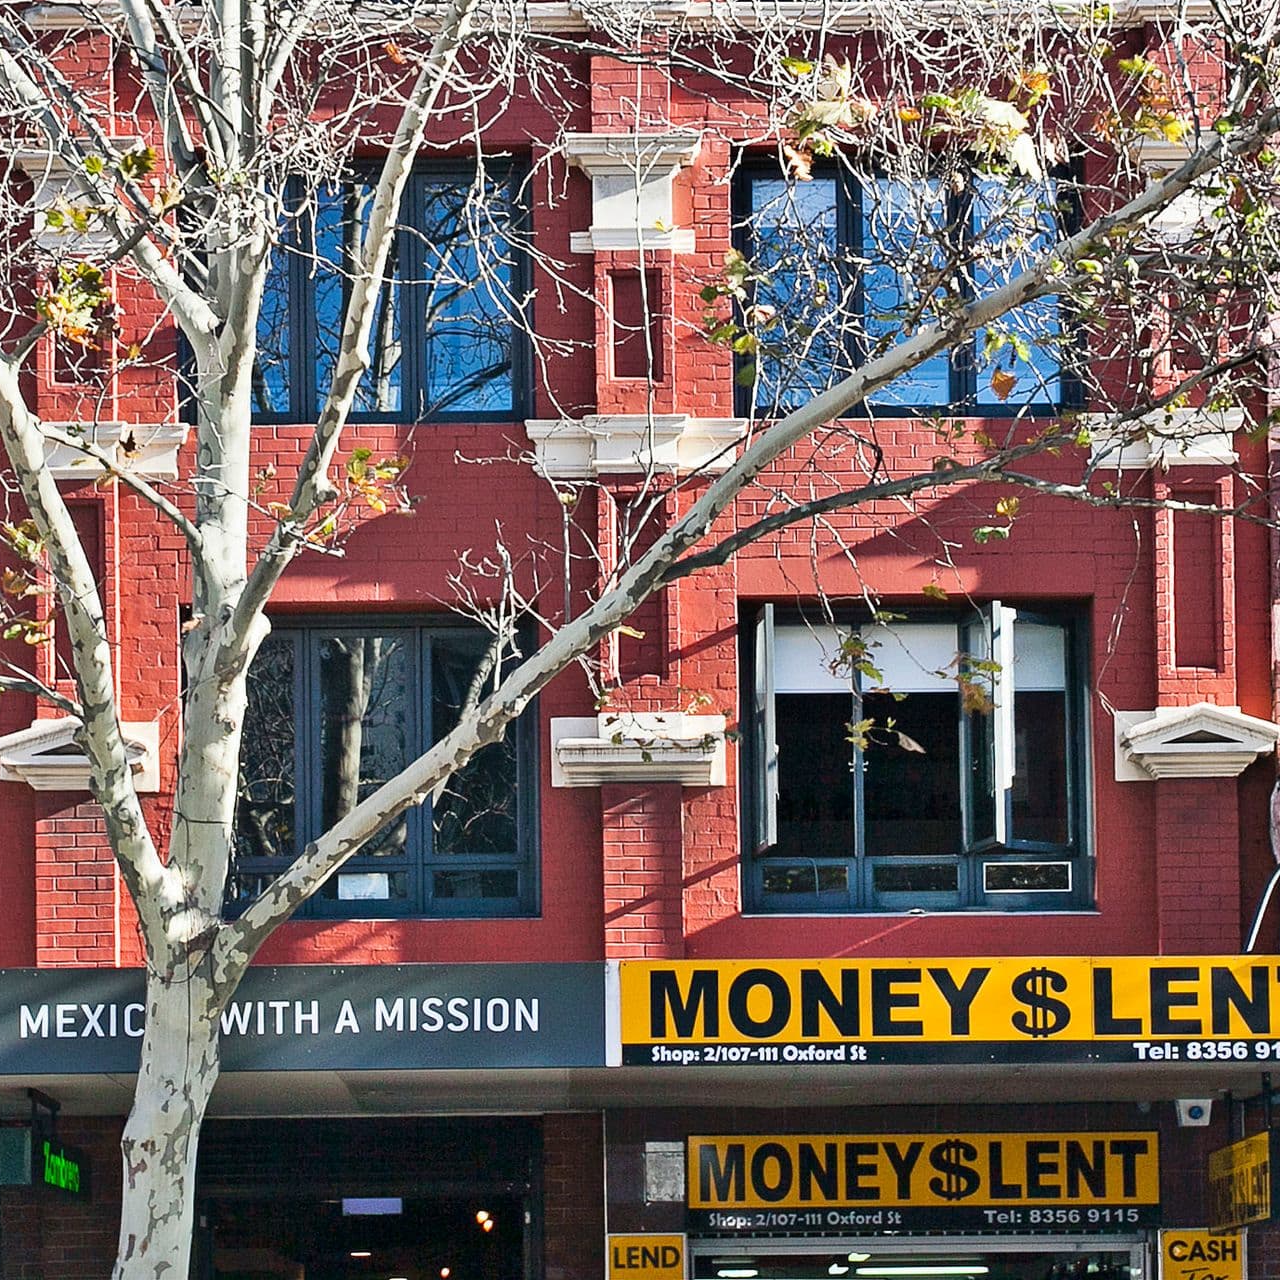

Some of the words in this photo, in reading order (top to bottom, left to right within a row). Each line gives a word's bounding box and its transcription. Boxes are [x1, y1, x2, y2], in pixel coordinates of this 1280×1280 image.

[20, 1004, 146, 1038] MEXIC
[220, 1001, 319, 1035] WITH
[334, 1000, 360, 1033] A
[376, 998, 540, 1032] MISSION
[652, 1046, 699, 1064] Shop:
[704, 1047, 777, 1062] 2/107-111
[783, 1045, 845, 1061] Oxford
[849, 1046, 867, 1061] St
[1133, 1043, 1178, 1059] Tel:
[1187, 1042, 1248, 1059] 8356
[709, 1211, 752, 1229] Shop:
[756, 1213, 821, 1226] 2/107-111
[827, 1211, 882, 1225] Oxford
[887, 1211, 901, 1224] St
[984, 1210, 1022, 1223] Tel:
[1030, 1209, 1080, 1223] 8356
[1088, 1209, 1139, 1222] 9115
[613, 1246, 680, 1269] LEND
[1169, 1240, 1236, 1261] CASH
